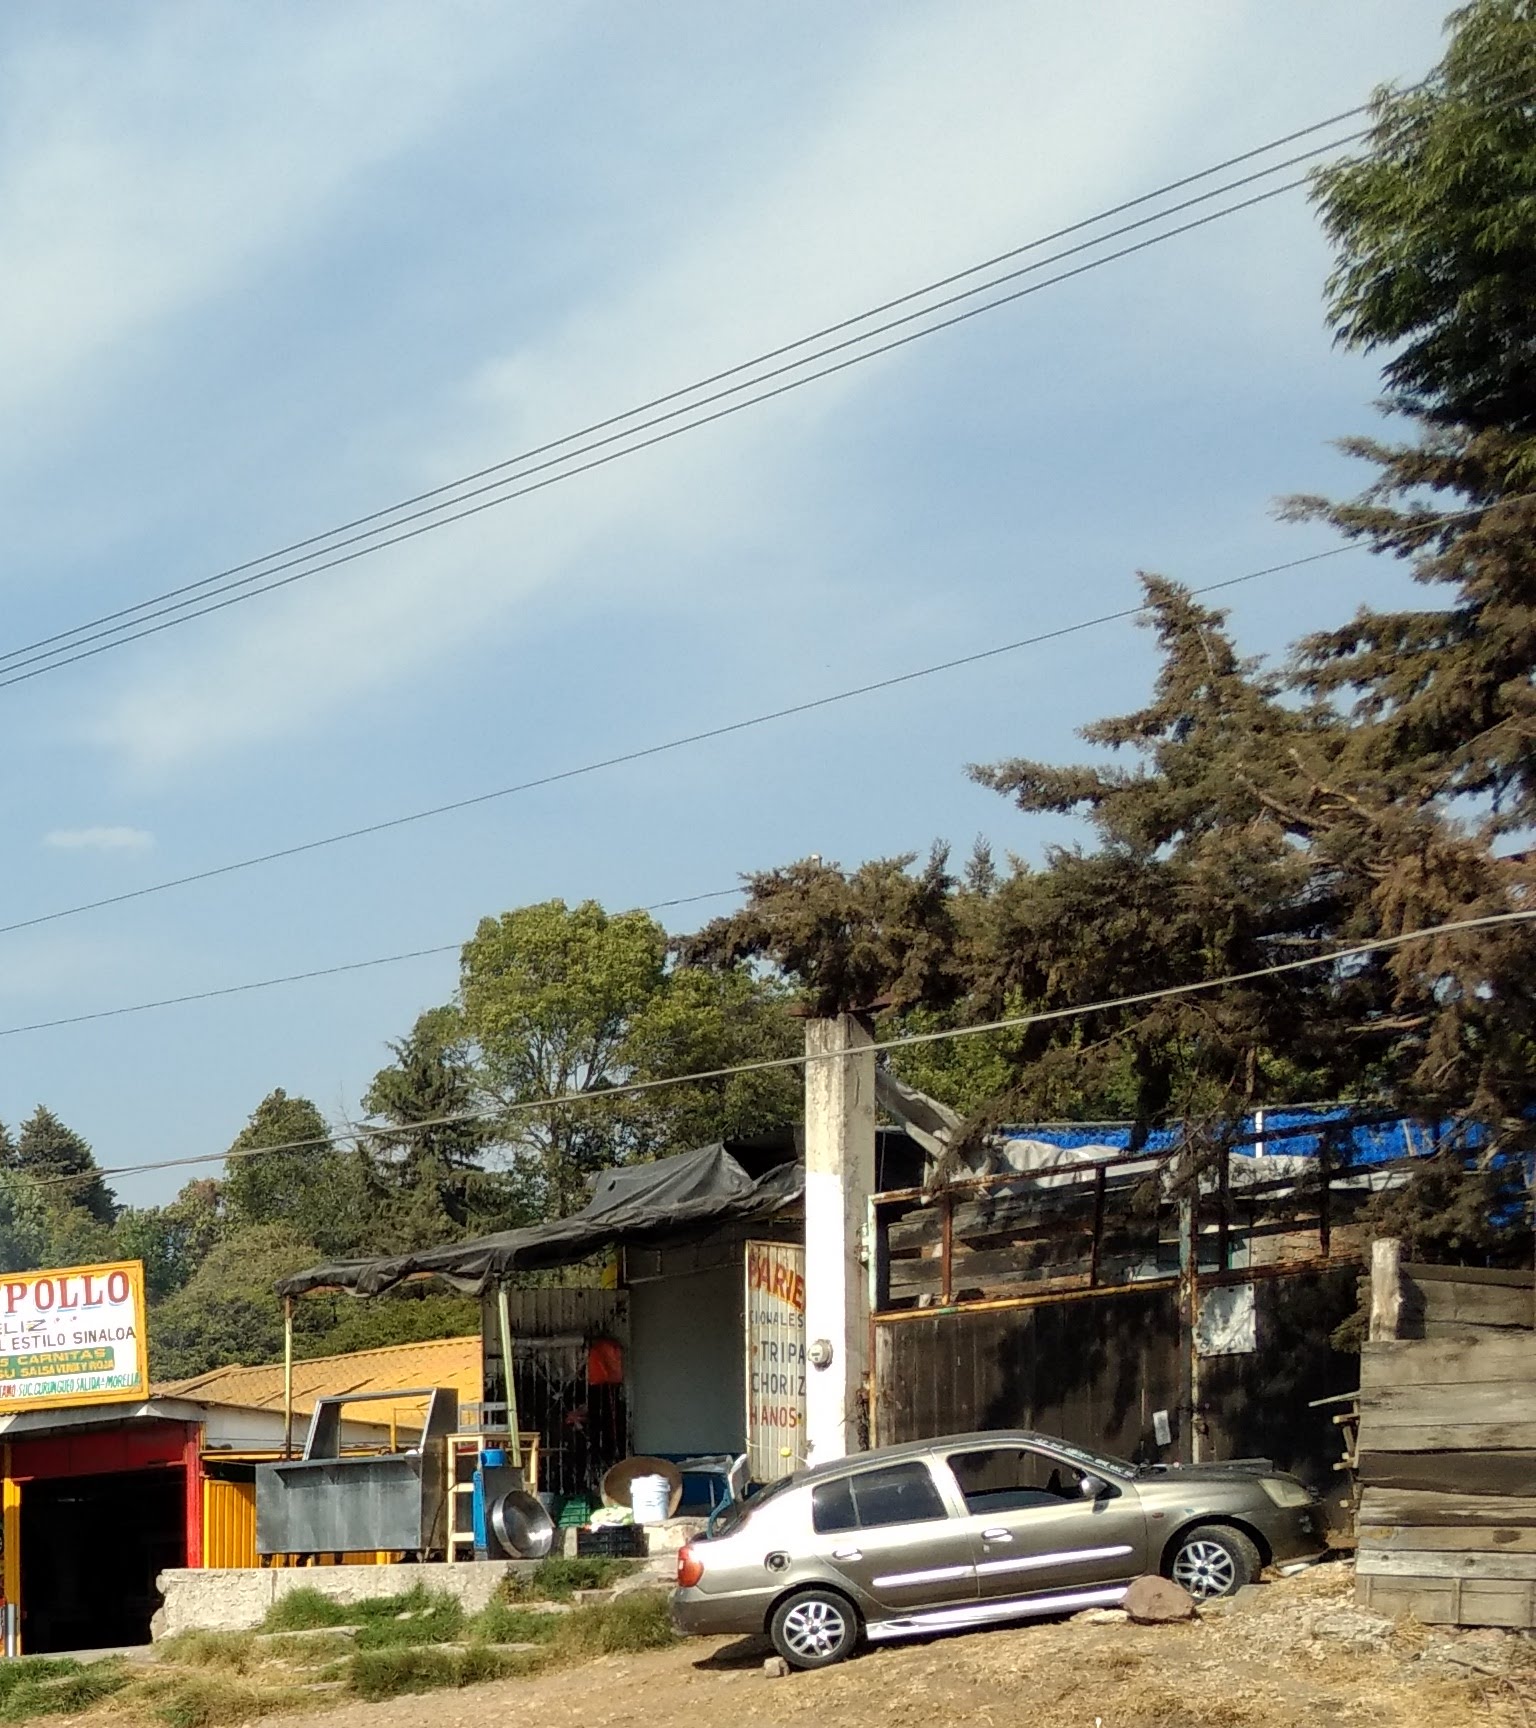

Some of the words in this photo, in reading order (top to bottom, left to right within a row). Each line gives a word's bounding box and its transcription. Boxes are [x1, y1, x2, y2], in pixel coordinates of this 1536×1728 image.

[4, 1270, 129, 1314] POLLO
[12, 1333, 66, 1351] ESTILO
[73, 1326, 137, 1345] SINALOA
[18, 1348, 106, 1366] CARNITAS
[20, 1364, 55, 1377] SALSA
[752, 1372, 805, 1396] CHORIZ
